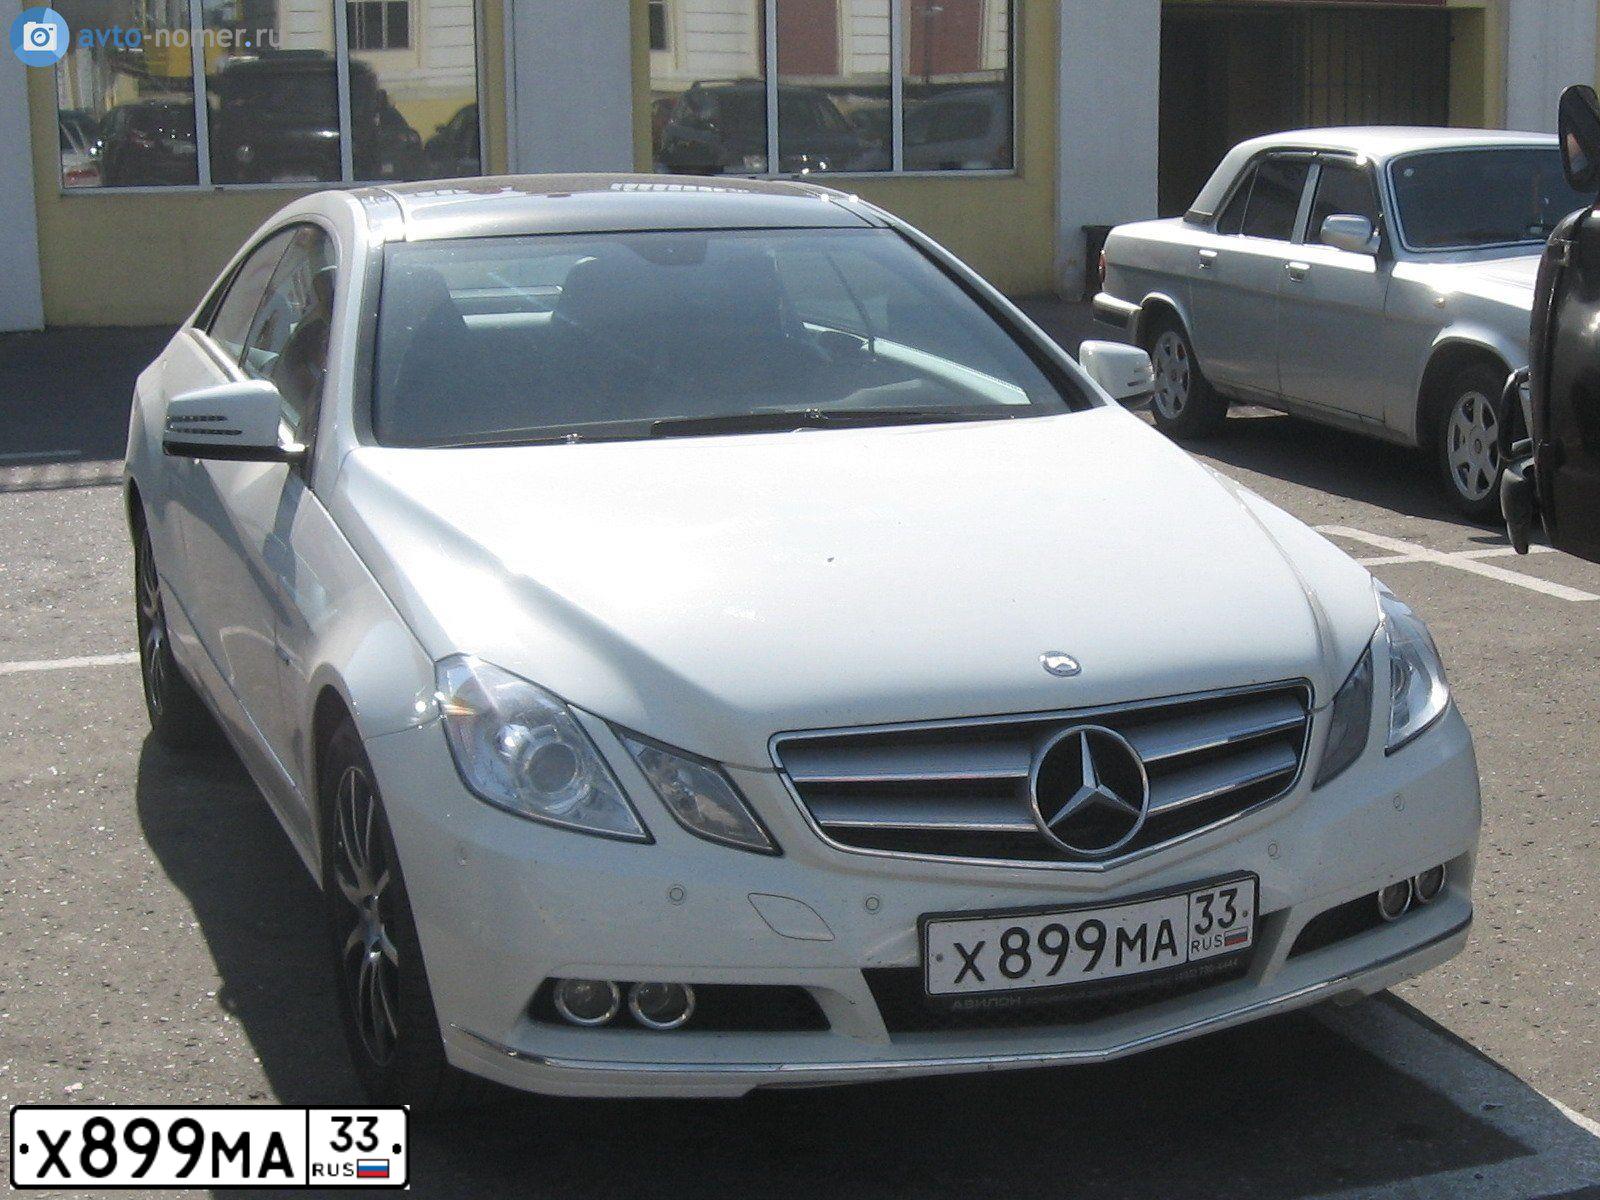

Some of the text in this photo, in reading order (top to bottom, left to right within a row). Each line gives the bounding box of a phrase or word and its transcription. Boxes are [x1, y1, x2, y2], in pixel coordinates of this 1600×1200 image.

[953, 918, 1178, 984] Х899МА
[1195, 888, 1239, 936] 33
[1191, 934, 1223, 954] RUS
